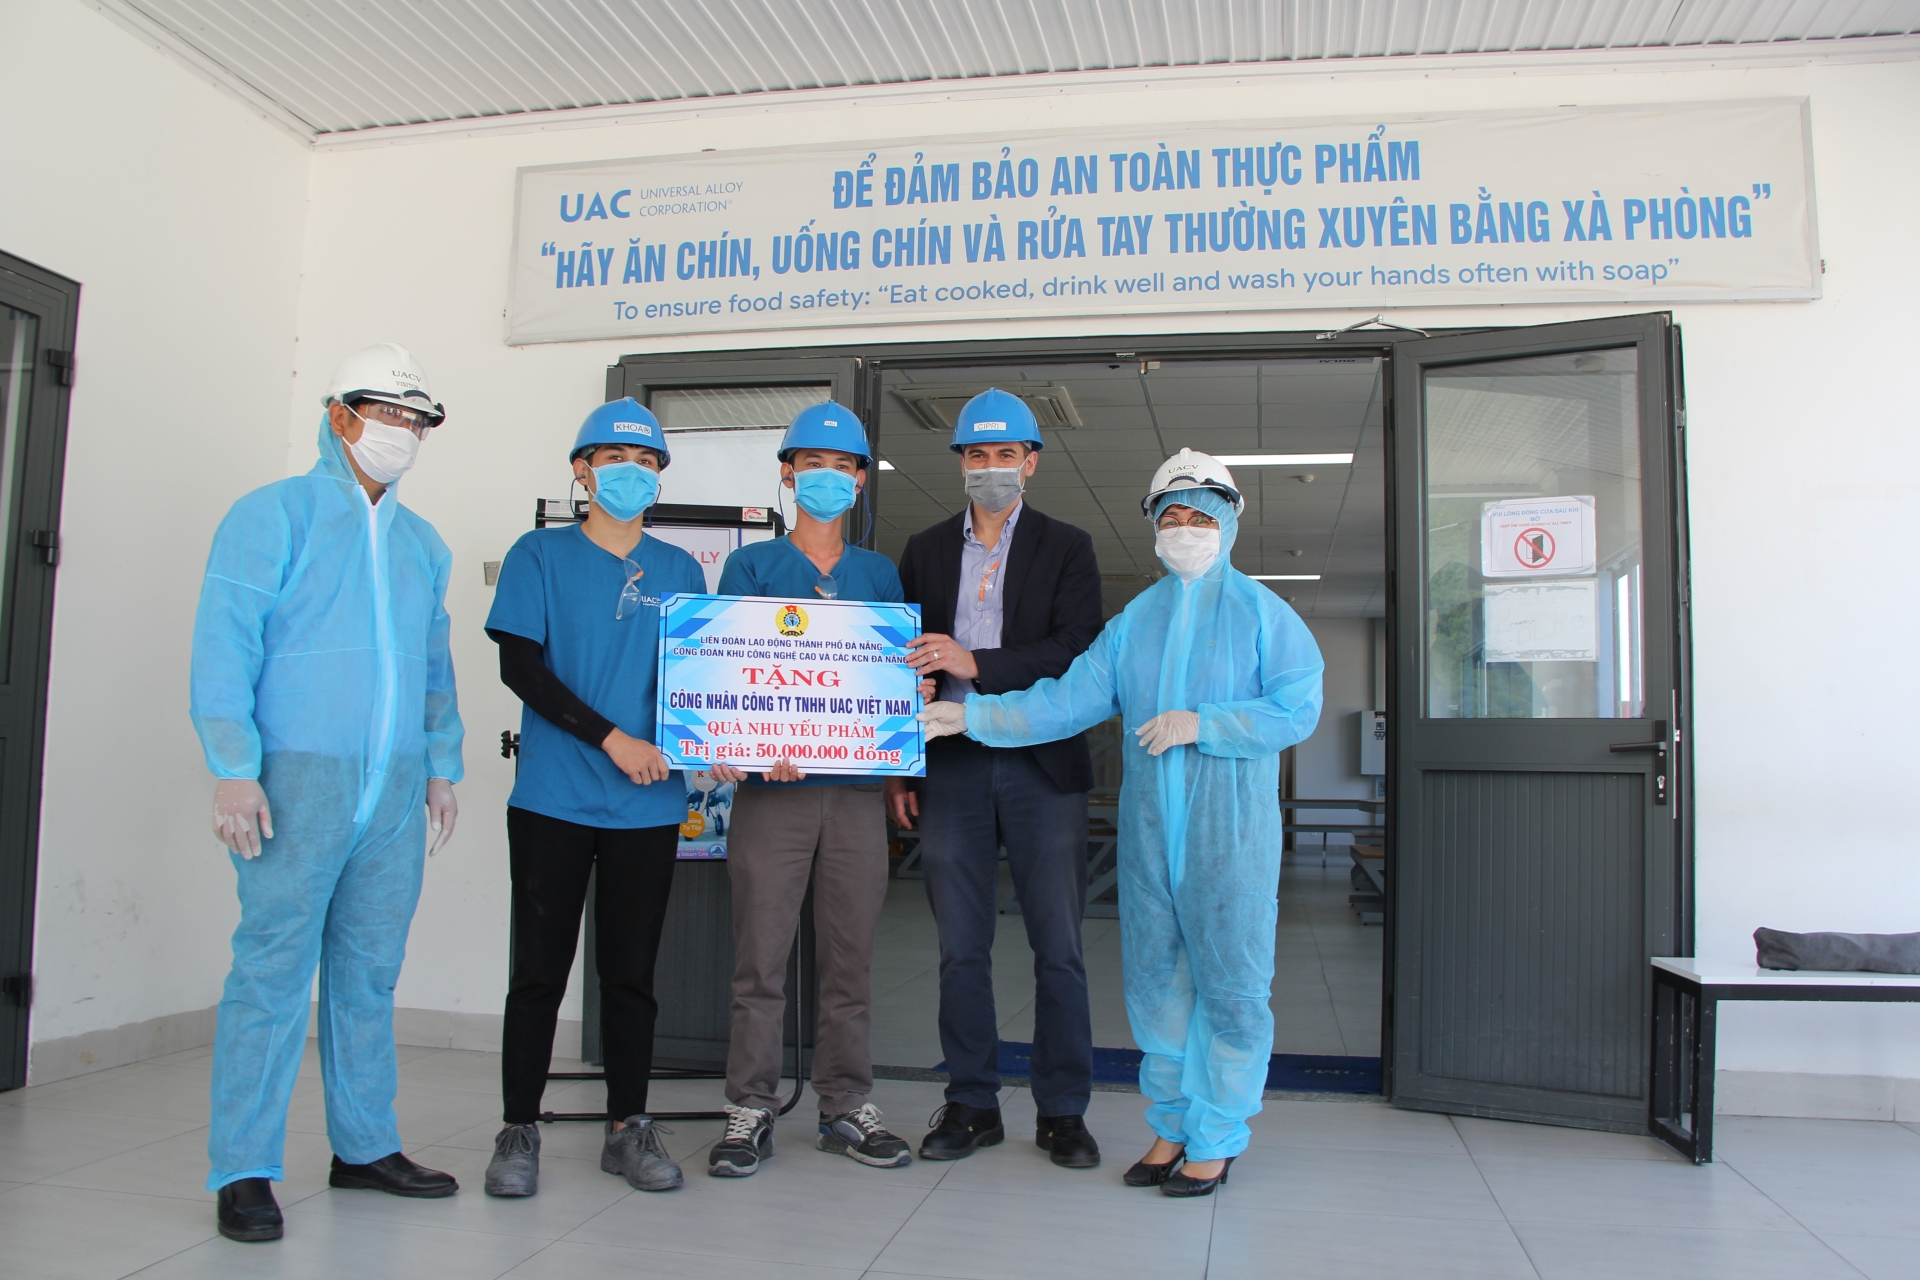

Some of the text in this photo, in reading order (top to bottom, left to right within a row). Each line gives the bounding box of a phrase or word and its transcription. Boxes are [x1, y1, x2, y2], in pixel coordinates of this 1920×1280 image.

[833, 123, 1421, 209] ĐỂ ĐẢM BẢO AN TOÀN THỰC PHẨM
[640, 181, 744, 200] UNIVERSAL ALLOY
[559, 188, 632, 223] UAC
[541, 182, 1772, 289] “HÃY ĂN CHÍN, UỐNG CHÍN VÀ RỬA TAY THƯỜNG XUYÊN BẰNG XÀ PHÒNG”
[613, 257, 1681, 320] To ensure food safety: “Eat cooked, drink well and wash your hands often with soap”
[391, 370, 422, 383] UACV
[977, 422, 1000, 430] CIPRI
[1168, 464, 1199, 474] UACV
[673, 645, 698, 656] CÔNG
[699, 647, 724, 657] ĐOÀN
[726, 649, 745, 659] KHU
[746, 649, 771, 659] CÔNG
[773, 650, 797, 662] NGHỆ
[799, 652, 817, 661] CAO
[819, 652, 830, 661] VÀ
[832, 652, 849, 662] CÁC
[851, 654, 869, 663] KCN
[871, 654, 883, 663] ĐÀ
[700, 635, 720, 645] LIÊN
[721, 636, 746, 646] ĐOÀN
[748, 638, 765, 647] LAO
[767, 637, 792, 649] ĐỘNG
[794, 638, 823, 649] THÀNH
[825, 639, 843, 650] PHỐ
[844, 640, 857, 650] ĐÀ
[742, 663, 842, 690] TẶNG
[670, 688, 911, 718] CÔNG NHÂN CÔNG TY TNHH UAC VIỆT NAM
[707, 718, 876, 739] QUÀ NHU YẾU PHẨM
[680, 740, 901, 765] Trị giá: 50.000.000 đồng
